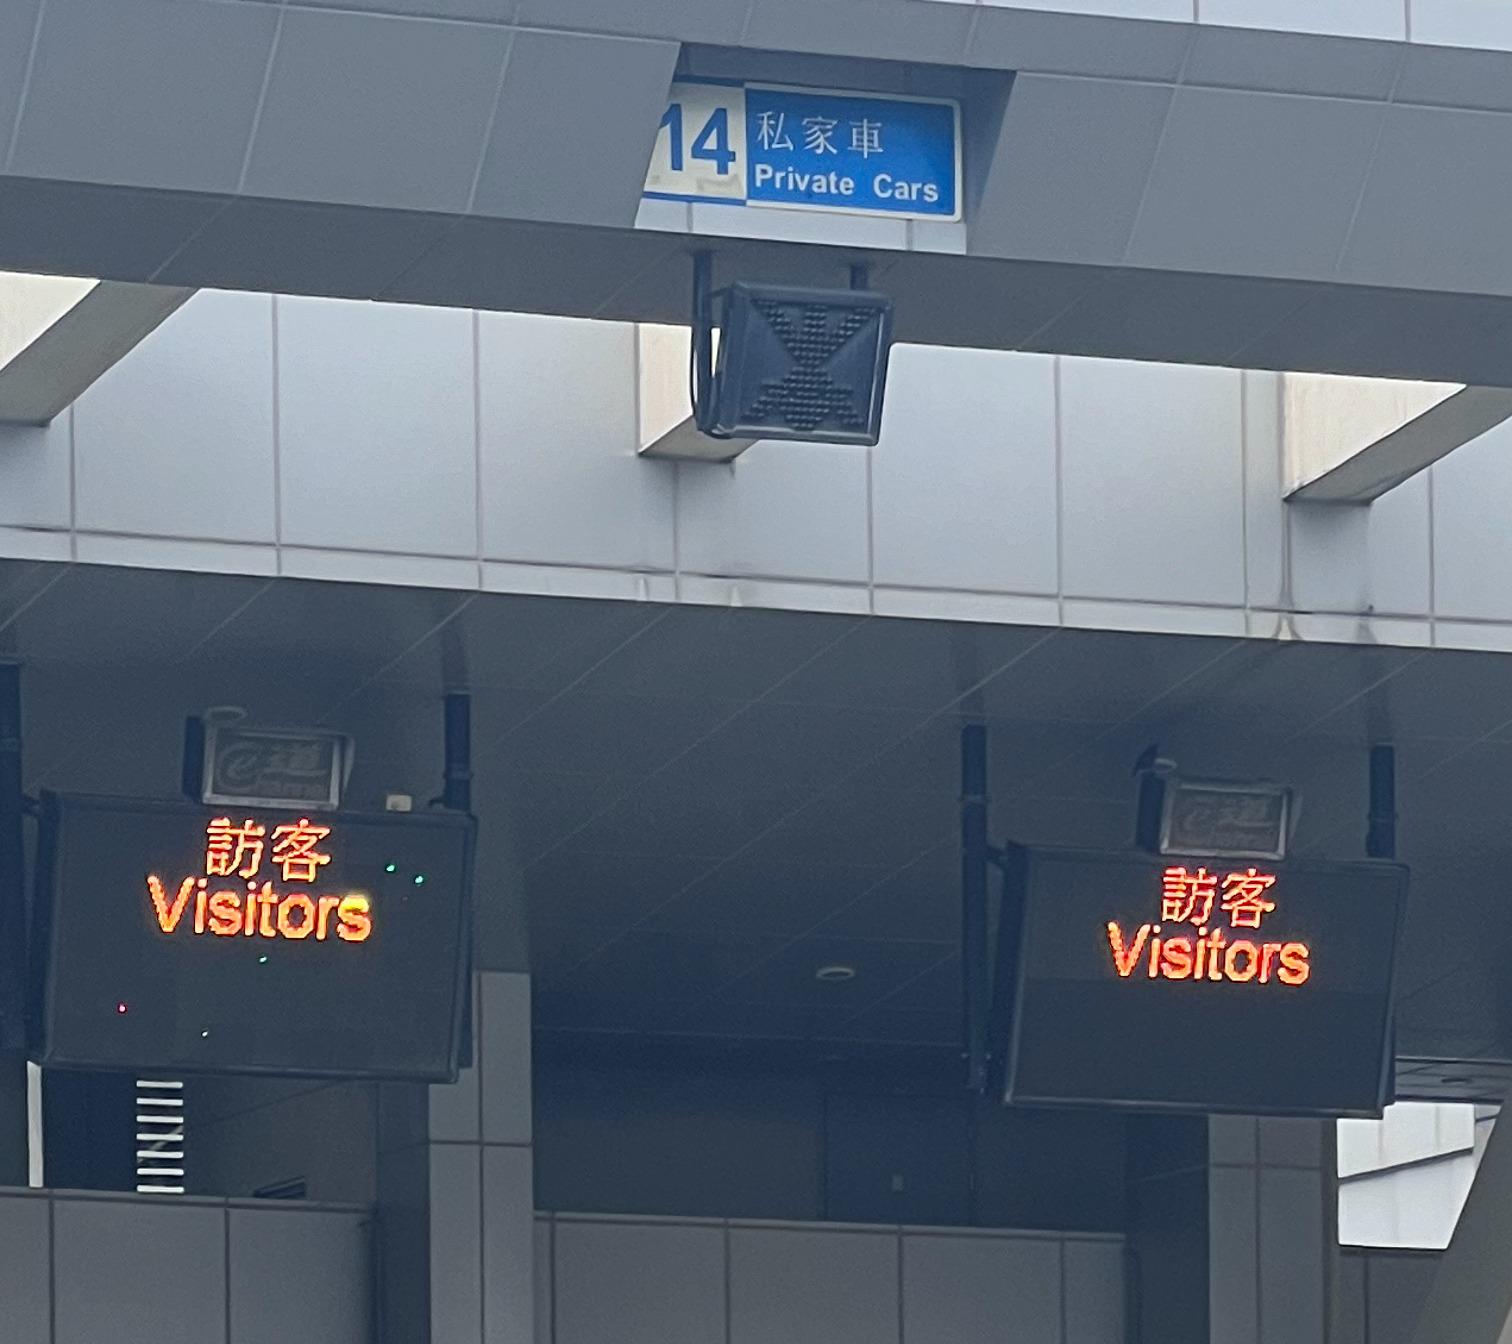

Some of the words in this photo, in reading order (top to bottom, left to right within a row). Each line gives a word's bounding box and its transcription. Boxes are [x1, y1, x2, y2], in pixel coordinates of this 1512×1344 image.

[659, 103, 736, 175] 14
[756, 111, 884, 159] 私家車
[755, 163, 855, 196] Private
[873, 174, 939, 203] Cars
[205, 816, 331, 882] 訪客
[146, 874, 372, 942] Visitors
[1161, 867, 1276, 929] 訪客
[1106, 921, 1312, 986] Visitors
